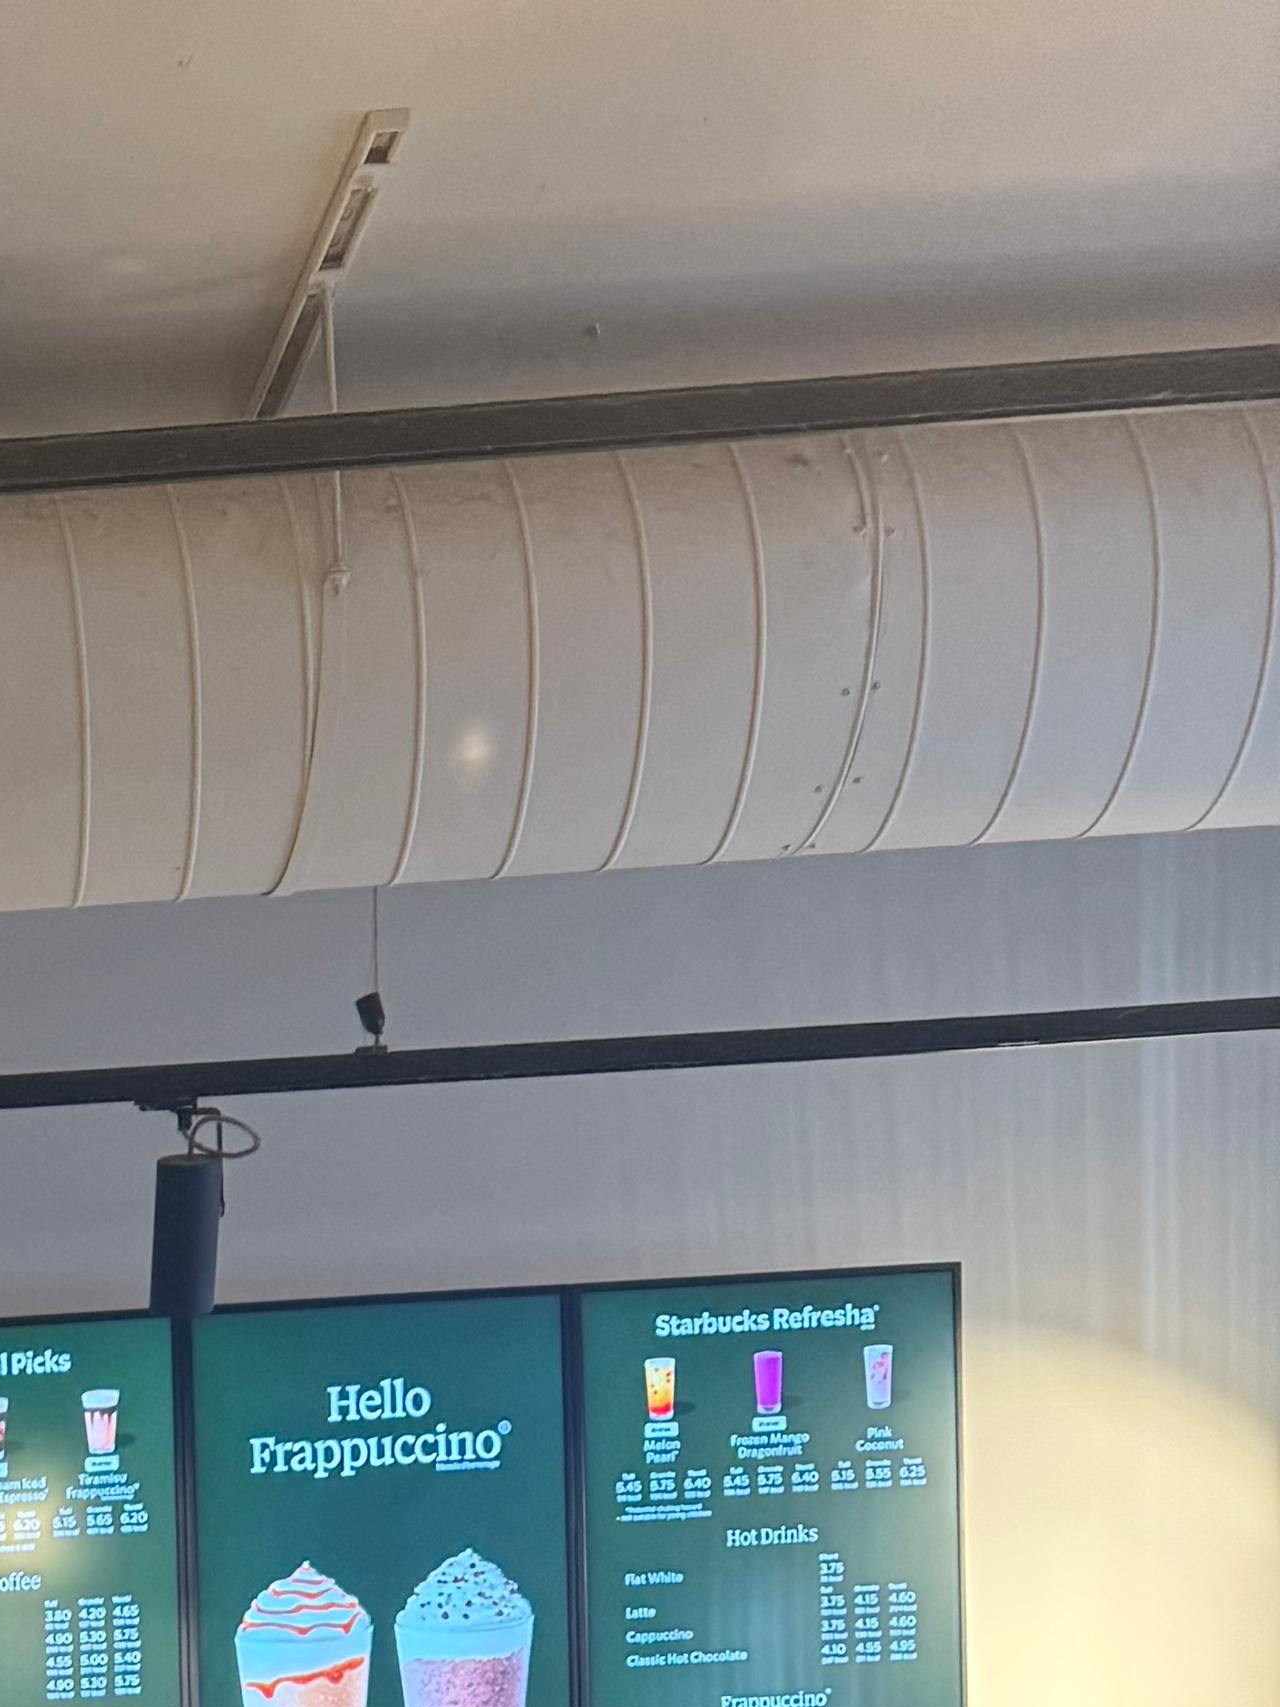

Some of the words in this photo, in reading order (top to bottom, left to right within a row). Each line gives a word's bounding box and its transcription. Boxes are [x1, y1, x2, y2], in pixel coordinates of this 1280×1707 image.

[655, 1309, 770, 1337] Starbucks
[12, 1349, 72, 1376] Picks
[327, 1377, 431, 1422] Hello
[730, 1434, 768, 1447] Frozen
[770, 1432, 810, 1445] Mango
[867, 1425, 892, 1439] Pink
[643, 1439, 681, 1453] Melon
[737, 1444, 803, 1460] Dragonfruit
[855, 1438, 904, 1452] Coconut
[726, 1527, 759, 1548] Hot
[761, 1524, 819, 1546] Drinks
[624, 1572, 647, 1586] Flat
[647, 1571, 684, 1584] White
[625, 1607, 657, 1620] Latte
[625, 1629, 694, 1644] Cappuccino
[626, 1654, 666, 1668] Classic
[667, 1652, 689, 1665] Hot
[690, 1650, 748, 1664] Chocolate
